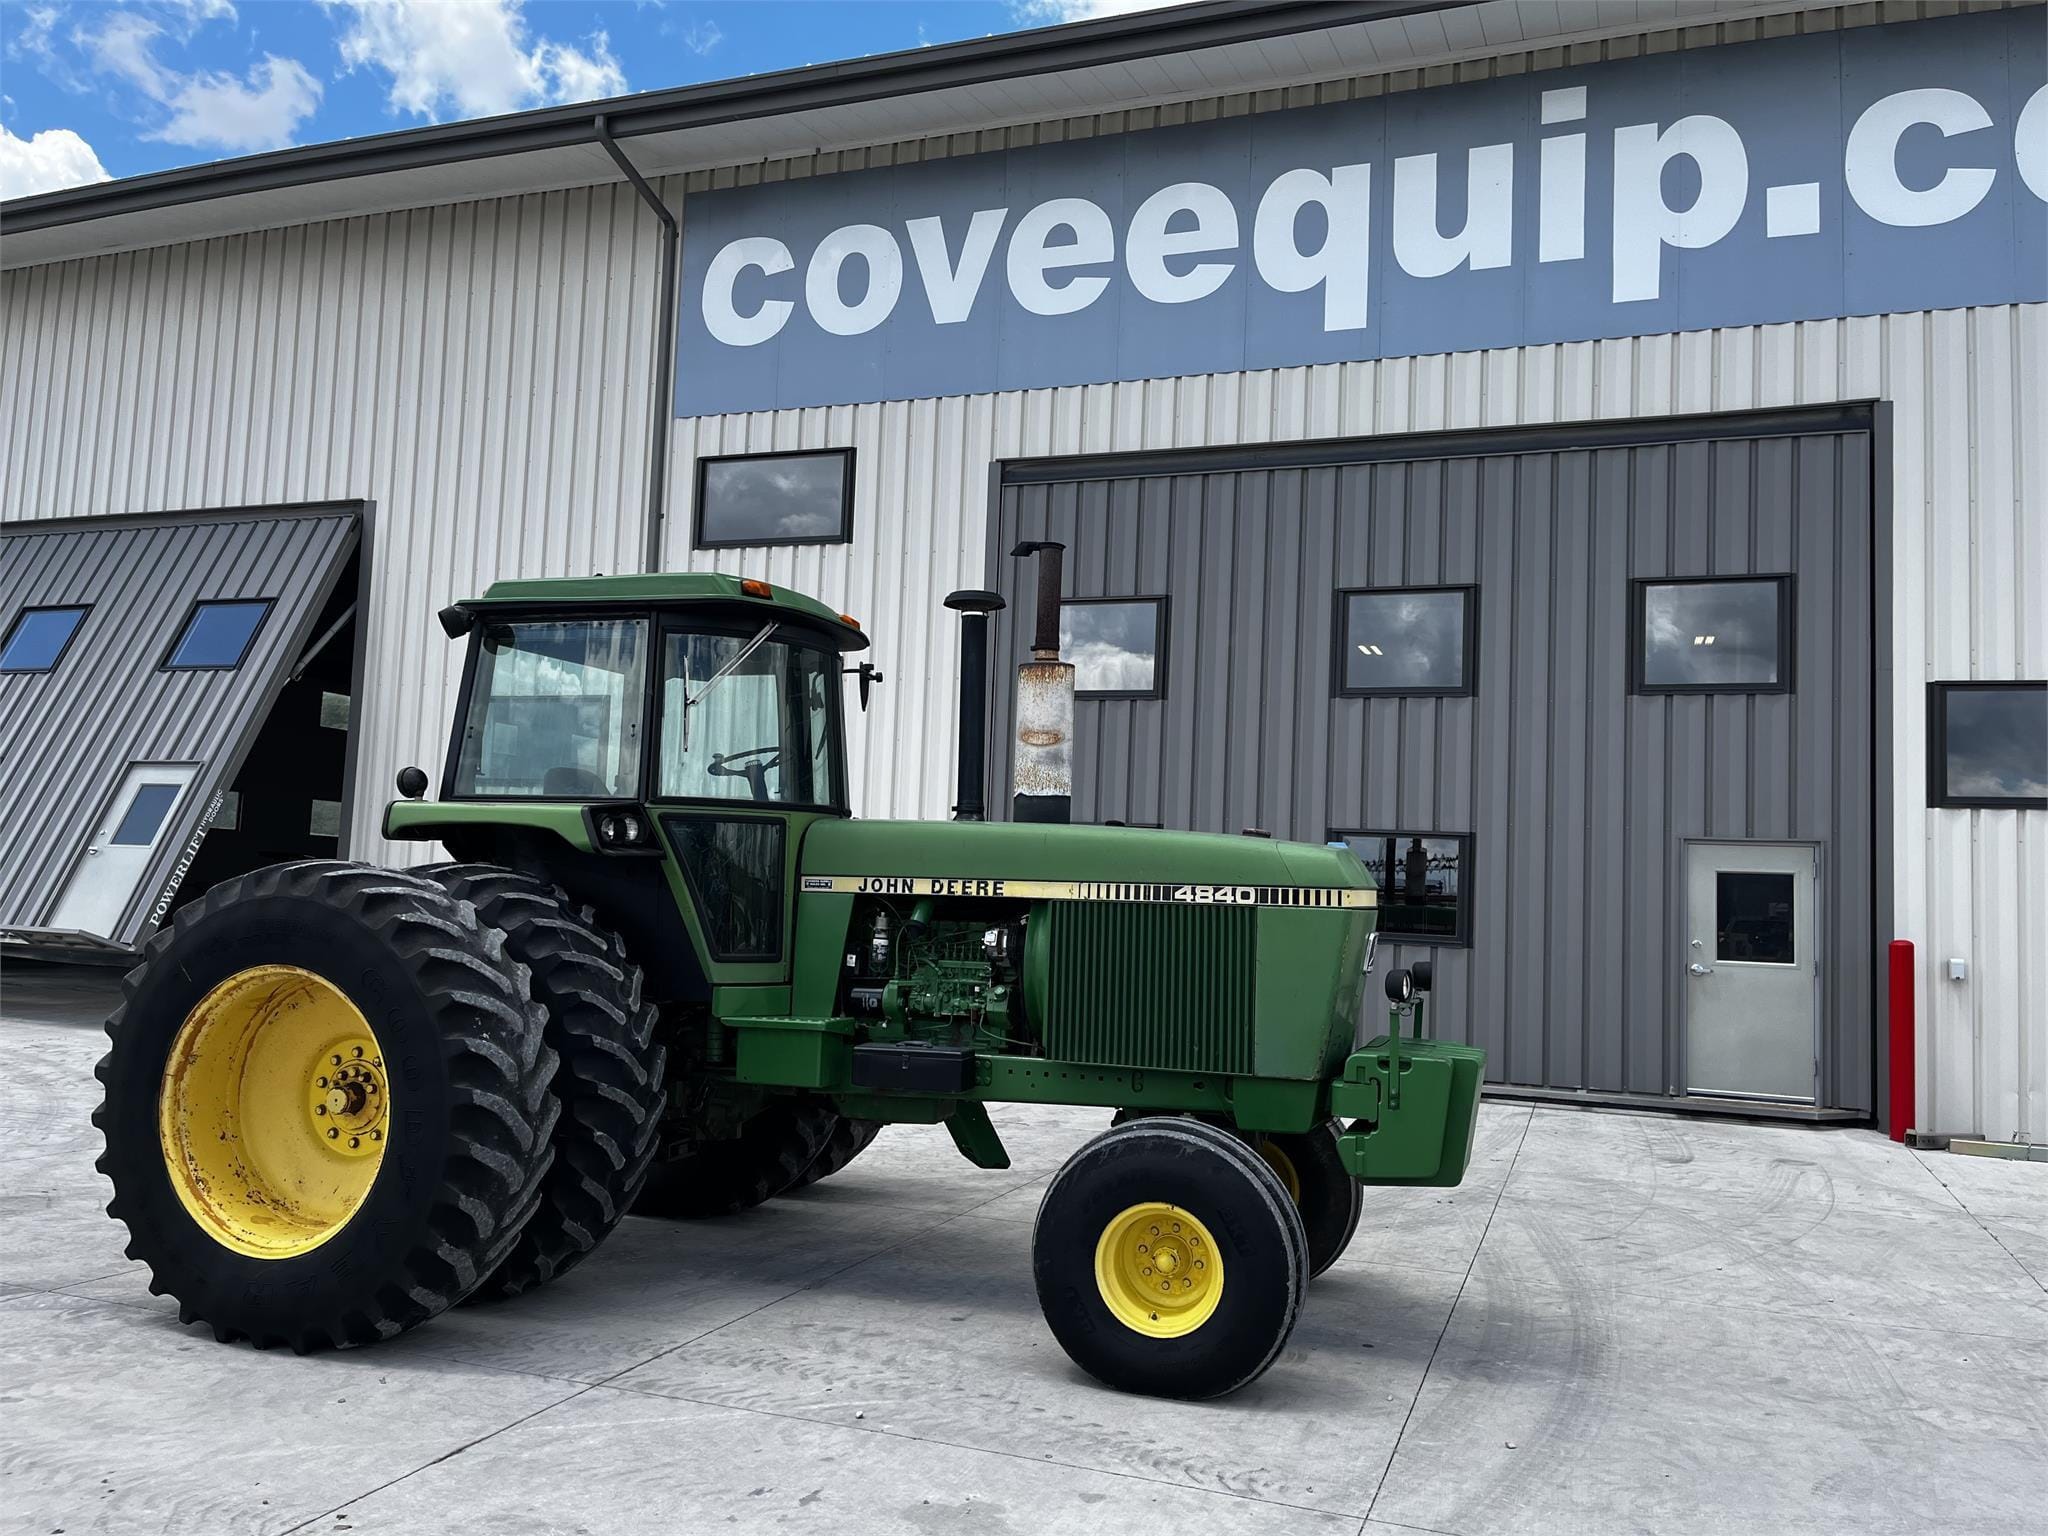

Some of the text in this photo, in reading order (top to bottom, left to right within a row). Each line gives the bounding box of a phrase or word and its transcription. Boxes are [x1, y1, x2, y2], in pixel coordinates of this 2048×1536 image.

[701, 82, 2048, 347] coveequip.c
[200, 788, 223, 827] HYDRAULIC
[148, 827, 206, 928] POWERLIFT
[858, 877, 1005, 896] JOHN DEERE
[1174, 885, 1256, 904] 4840
